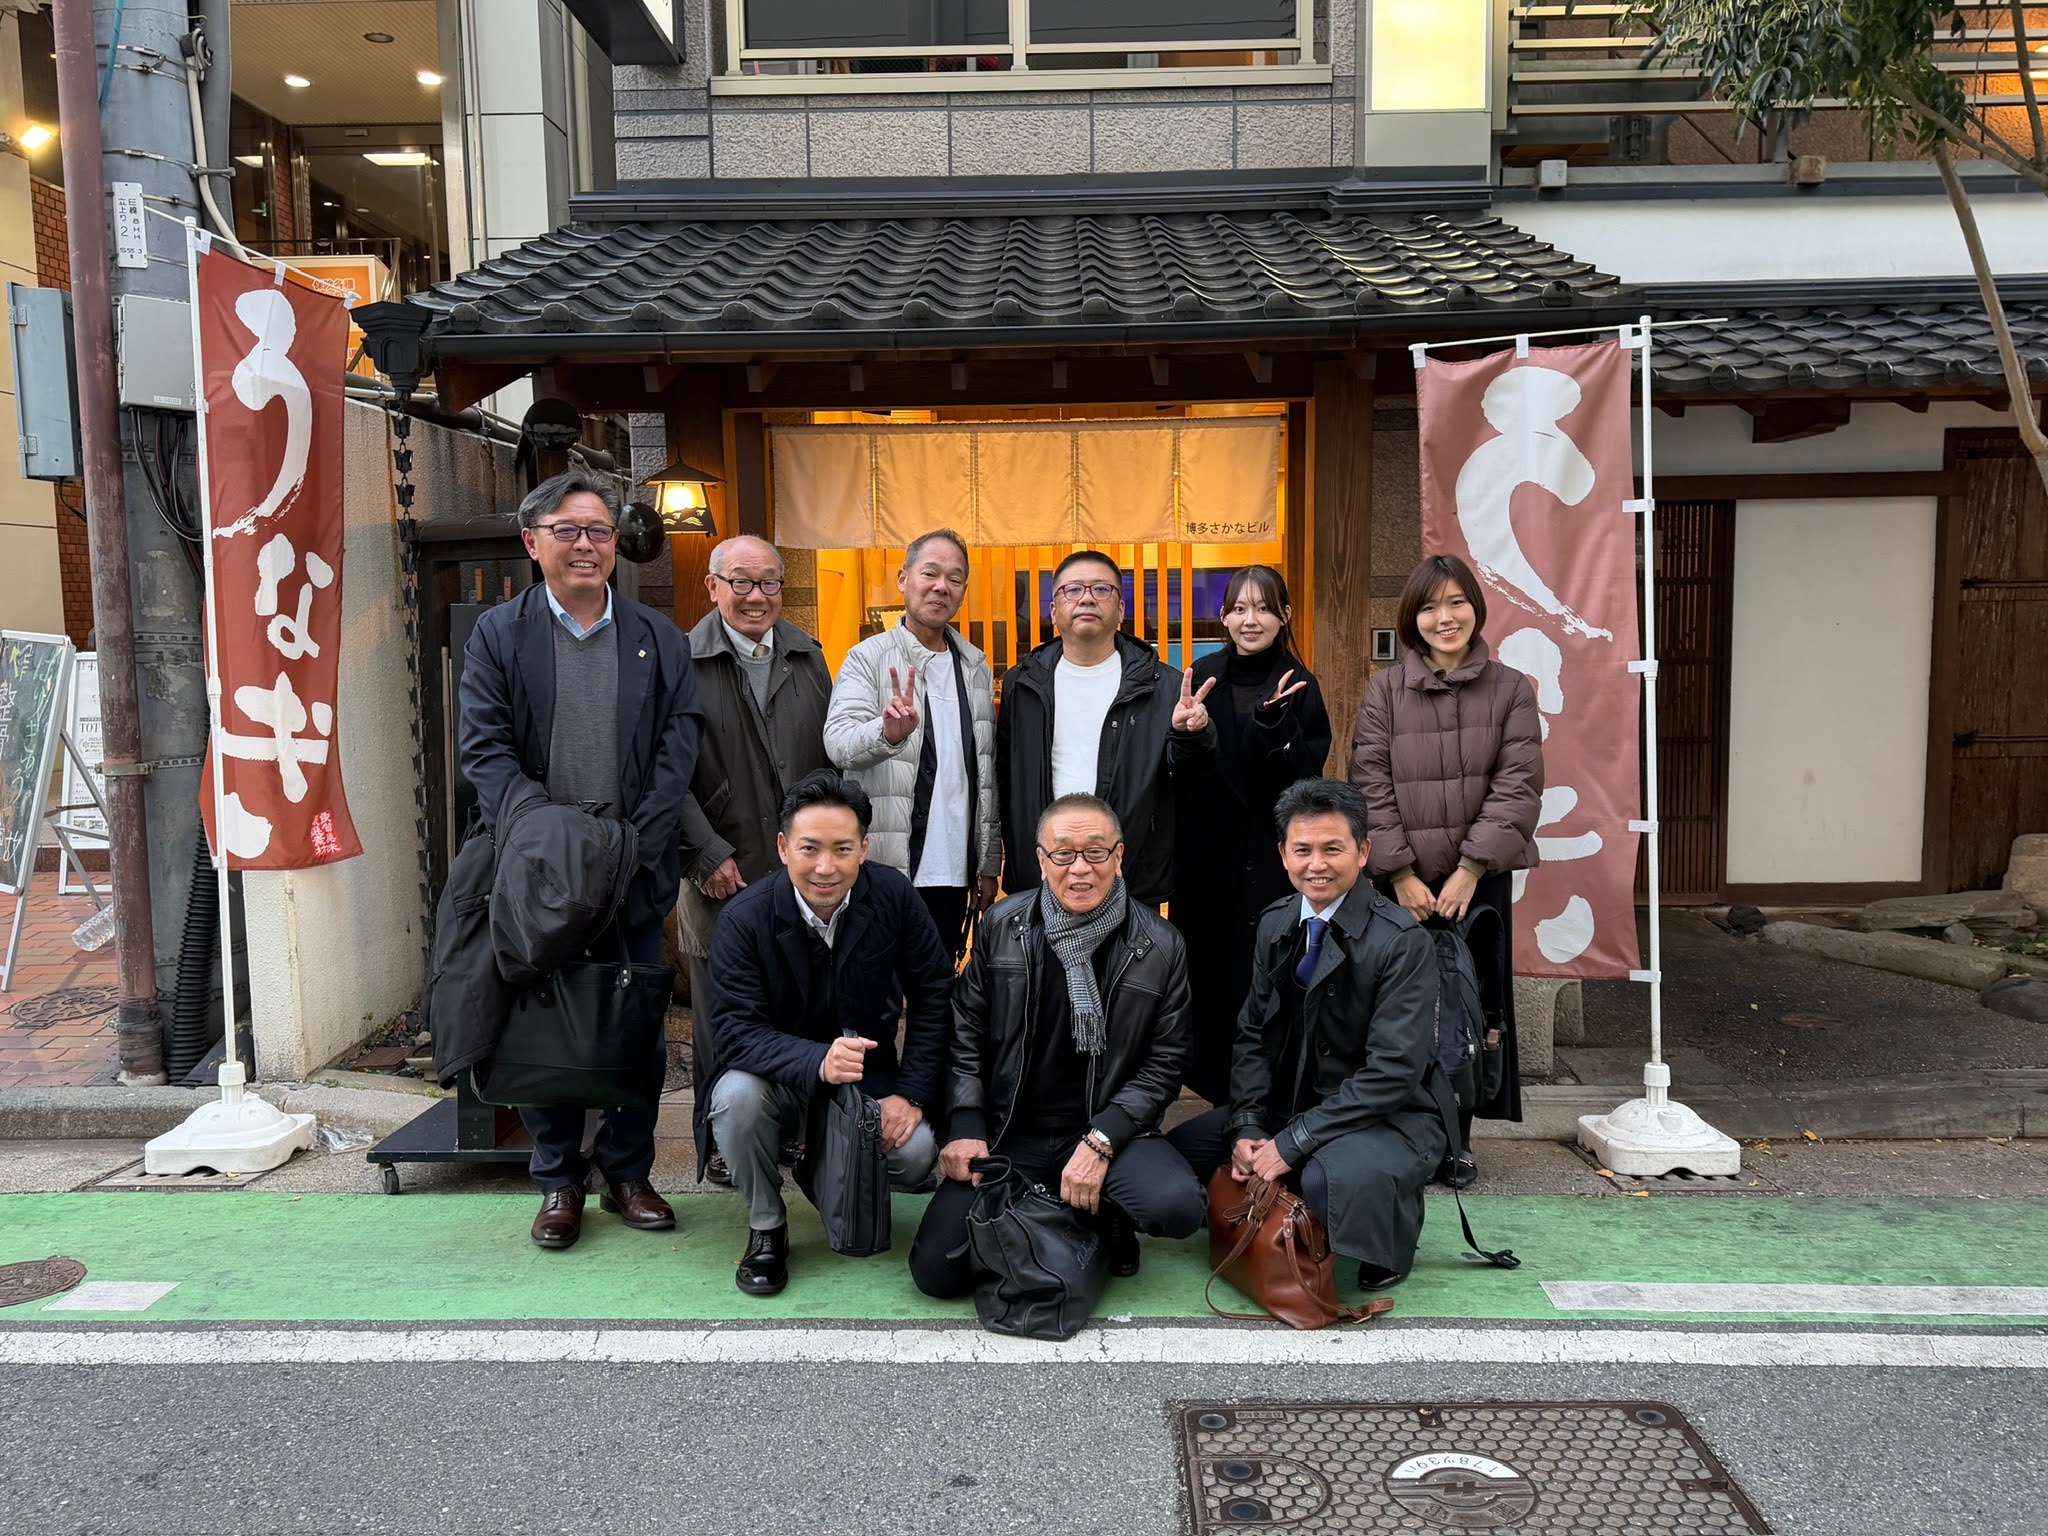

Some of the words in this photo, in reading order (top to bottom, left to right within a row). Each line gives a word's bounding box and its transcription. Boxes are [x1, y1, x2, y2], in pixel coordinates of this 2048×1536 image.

[120, 226, 129, 237] 2
[1186, 521, 1270, 534] 博多さかなビル
[211, 288, 333, 859] うなぎ
